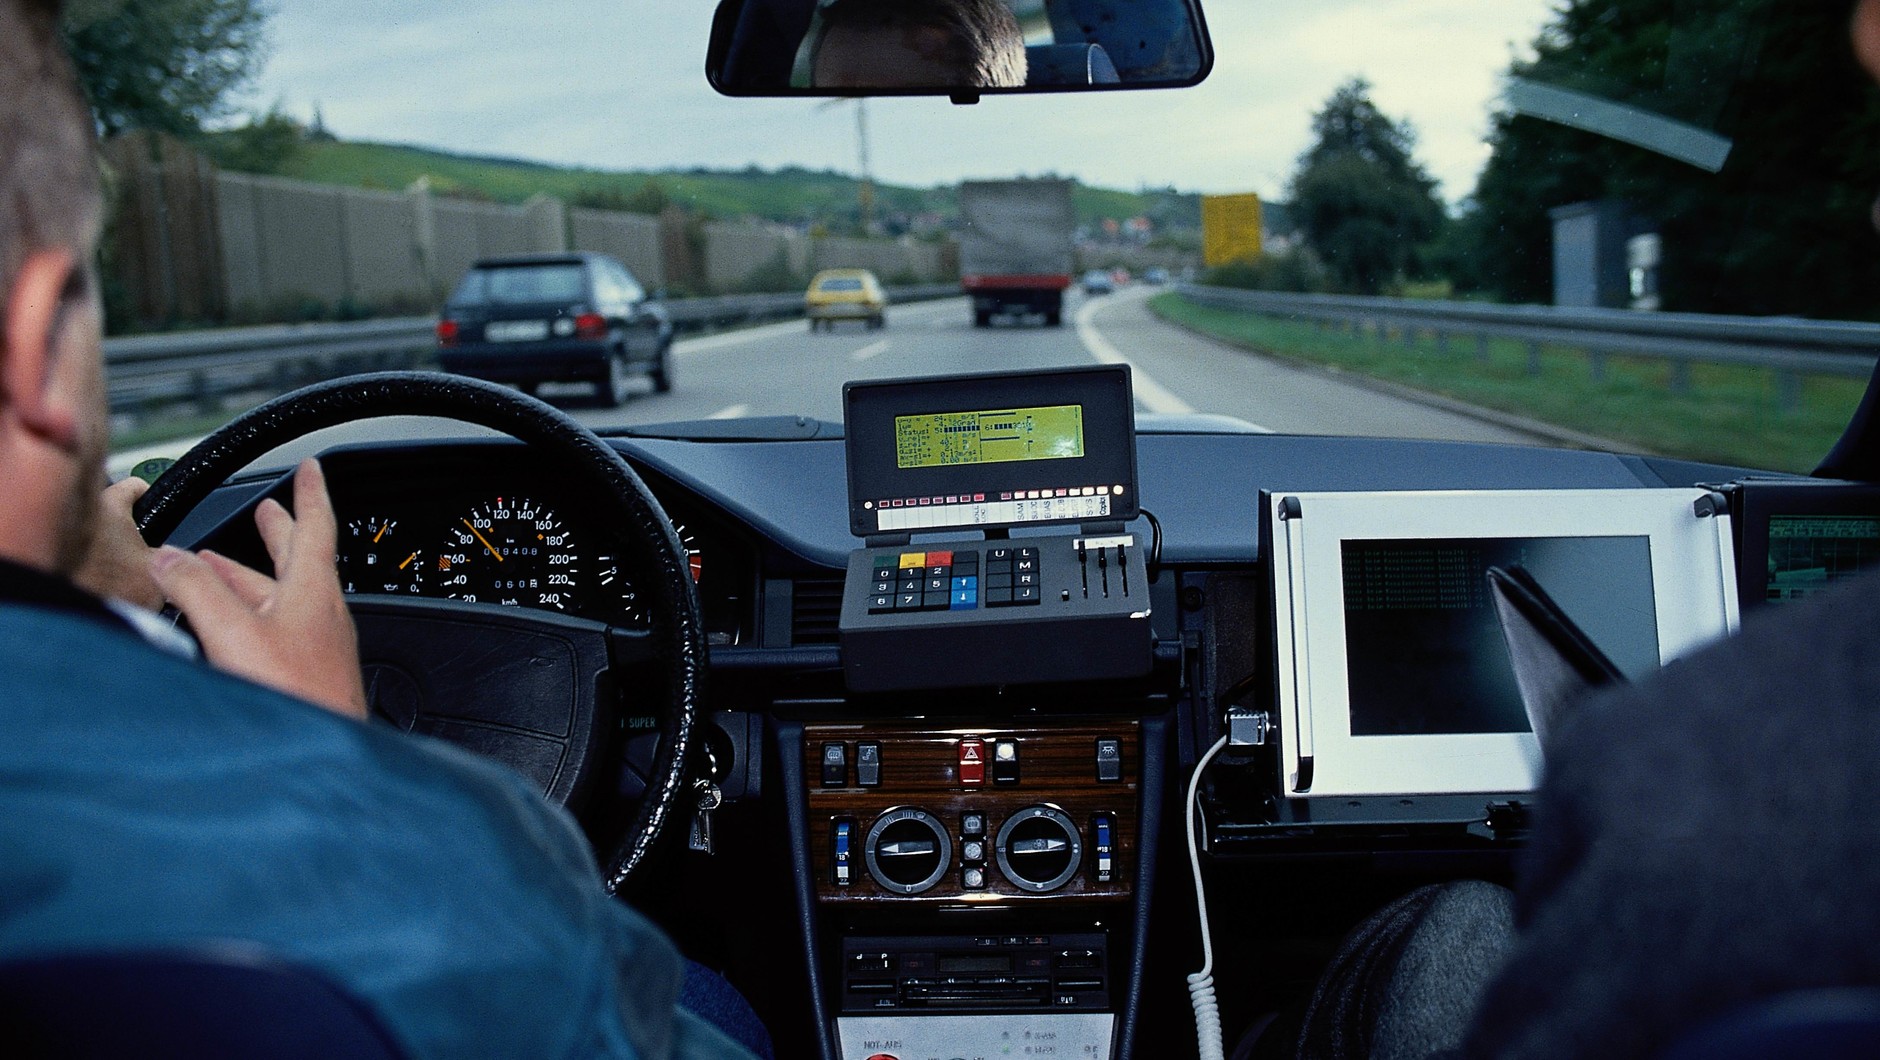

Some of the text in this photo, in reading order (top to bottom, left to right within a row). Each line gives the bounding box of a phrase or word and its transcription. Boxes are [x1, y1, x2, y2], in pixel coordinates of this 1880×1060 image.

[493, 509, 510, 519] 120
[517, 510, 534, 520] 140
[473, 519, 491, 529] 100
[535, 520, 553, 530] 160
[353, 528, 359, 536] R
[460, 534, 474, 544] 80
[546, 536, 563, 546] 180
[1022, 548, 1029, 556] L
[451, 554, 465, 564] 60
[549, 554, 569, 565] 200
[413, 562, 419, 570] 2
[1019, 561, 1031, 569] M
[453, 574, 467, 585] 40
[548, 574, 568, 584] 220
[410, 584, 417, 592] 0
[1022, 589, 1030, 597] J
[462, 594, 476, 603] 20
[539, 593, 560, 604] 240
[629, 717, 655, 728] SUPER
